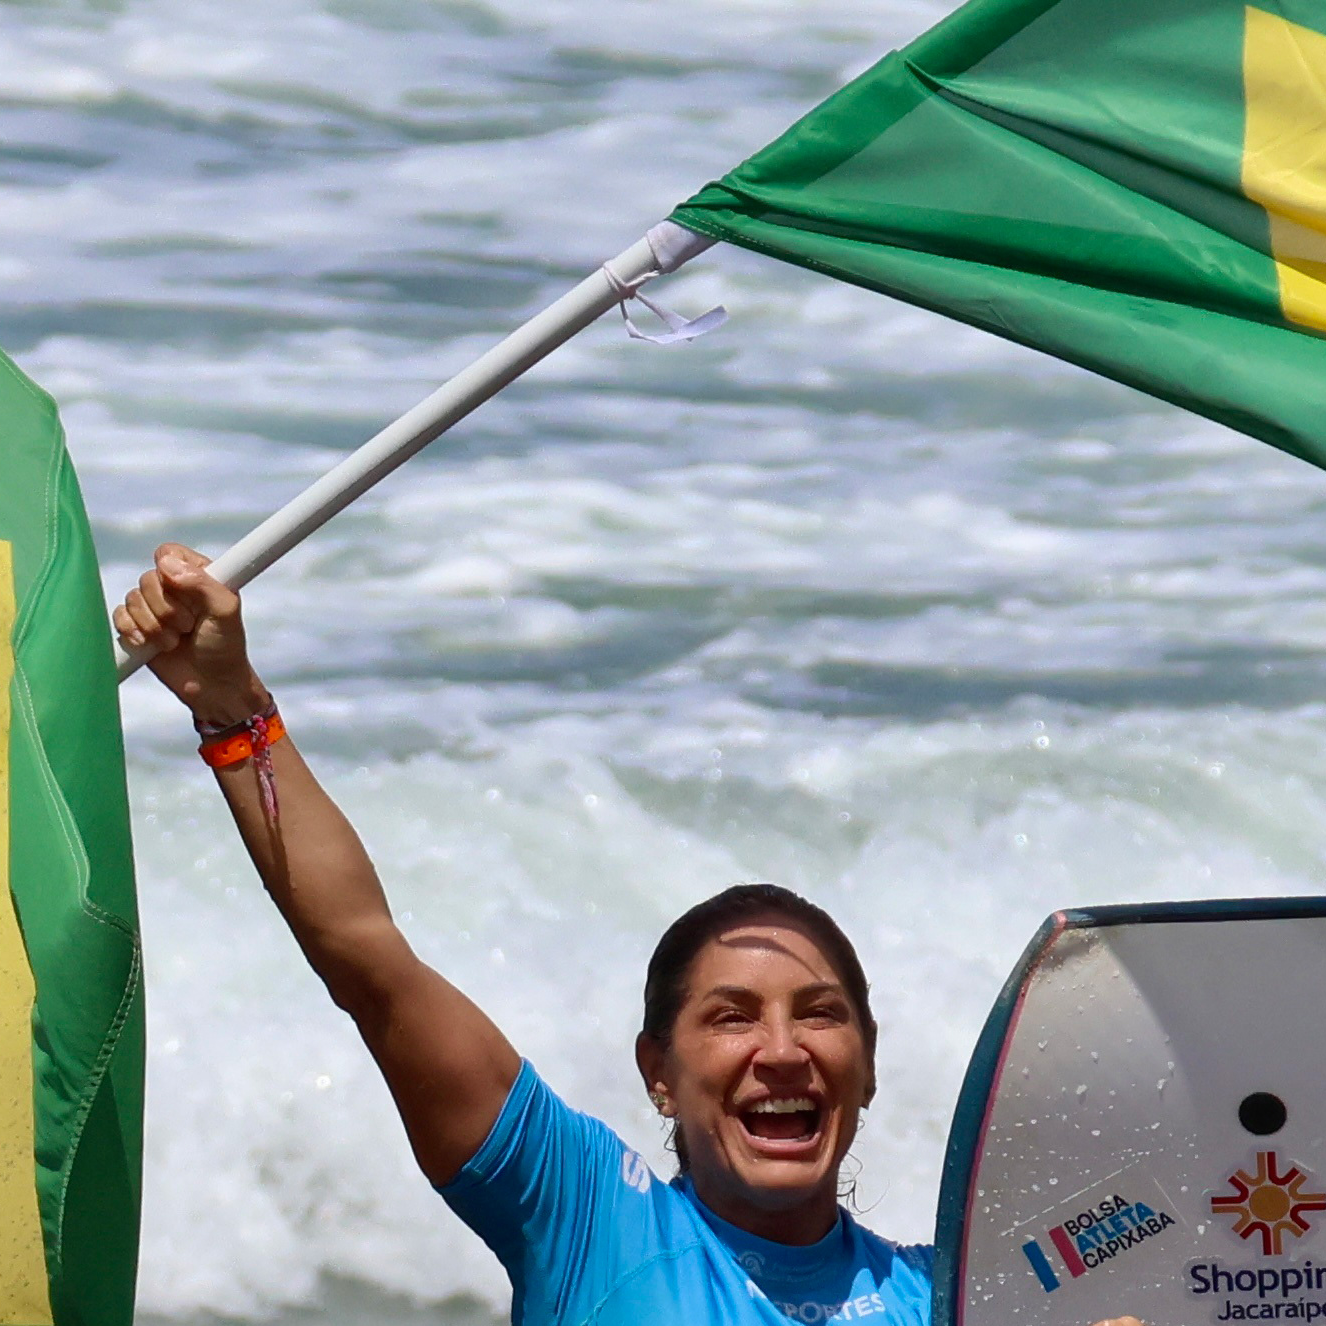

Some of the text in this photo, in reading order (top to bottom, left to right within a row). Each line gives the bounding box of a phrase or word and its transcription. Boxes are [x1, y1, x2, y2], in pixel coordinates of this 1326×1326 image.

[1064, 1195, 1130, 1236] BOLSA
[1076, 1202, 1156, 1254] ATLETA
[1083, 1212, 1176, 1269] CAPIXABA
